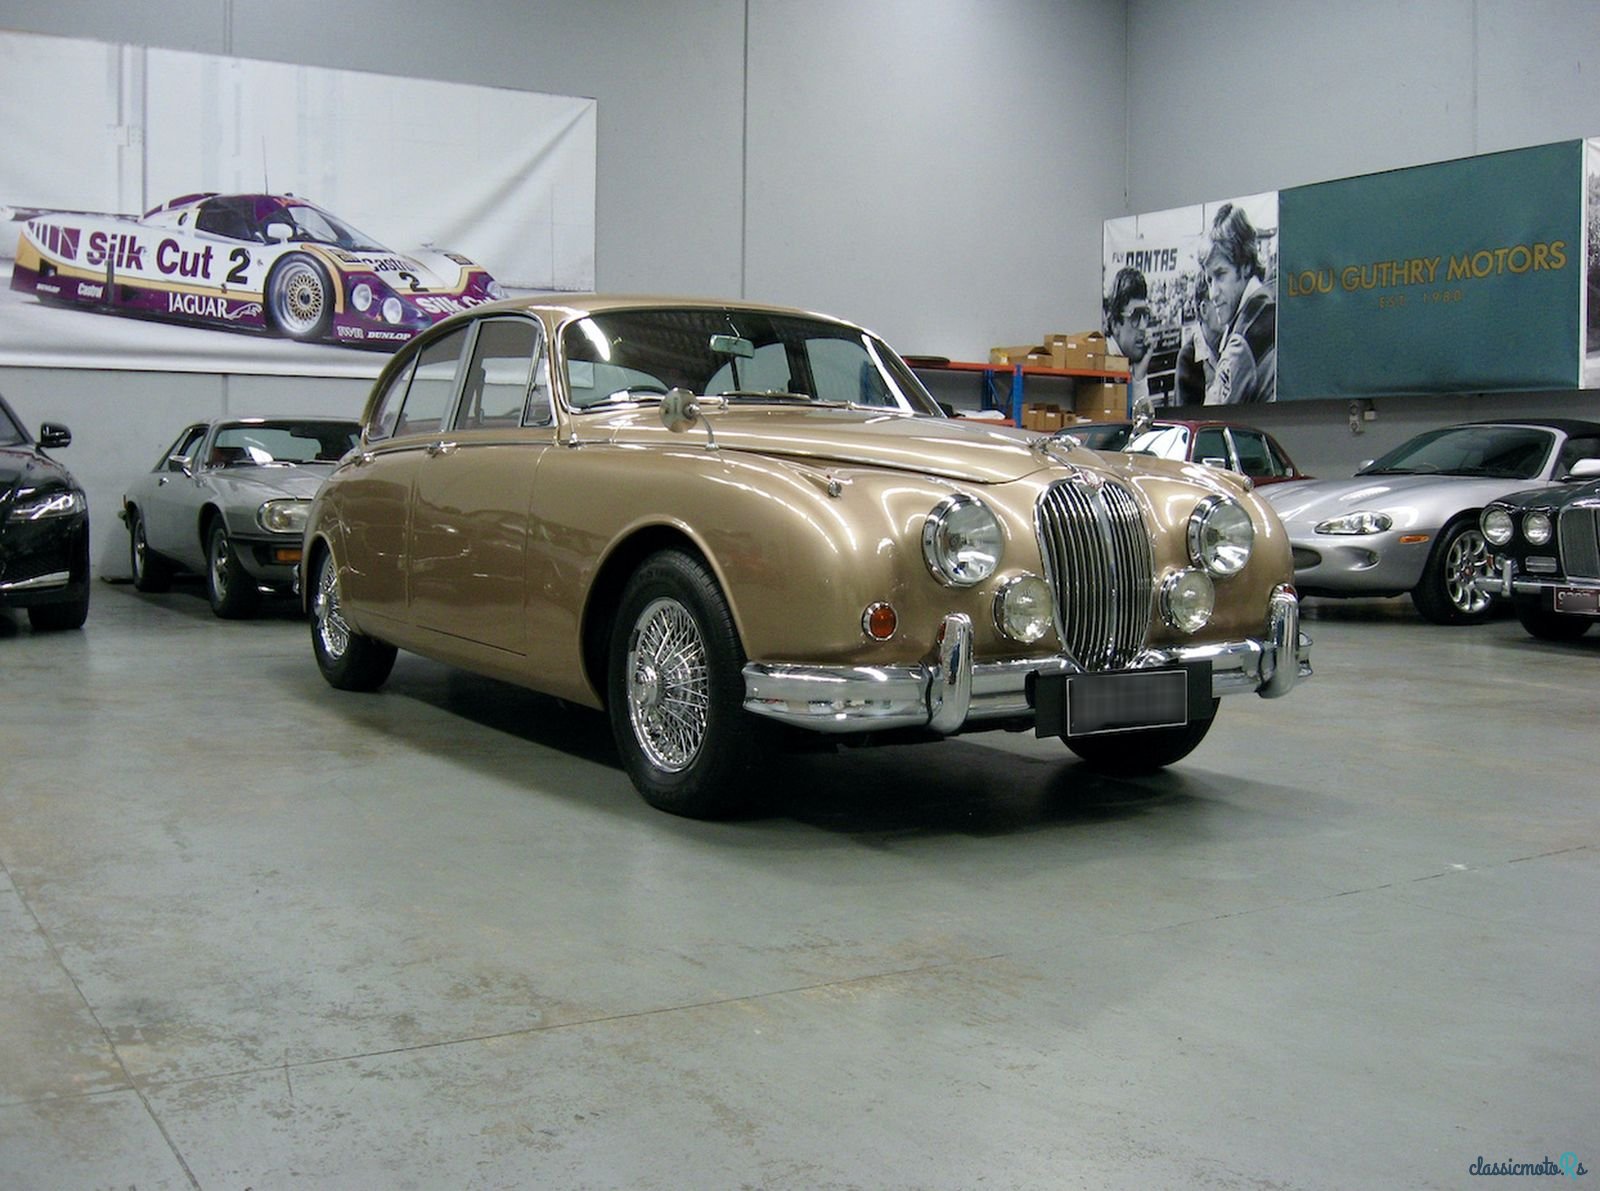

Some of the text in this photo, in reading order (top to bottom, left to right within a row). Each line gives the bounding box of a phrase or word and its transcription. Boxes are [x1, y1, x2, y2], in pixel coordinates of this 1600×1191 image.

[87, 231, 213, 279] Silk Cut
[226, 248, 251, 284] 2
[1288, 241, 1568, 297] LOU GUTHRY MOTORS
[399, 272, 429, 292] 2
[168, 292, 228, 318] JAGUAR
[367, 331, 412, 340] DUNLOP
